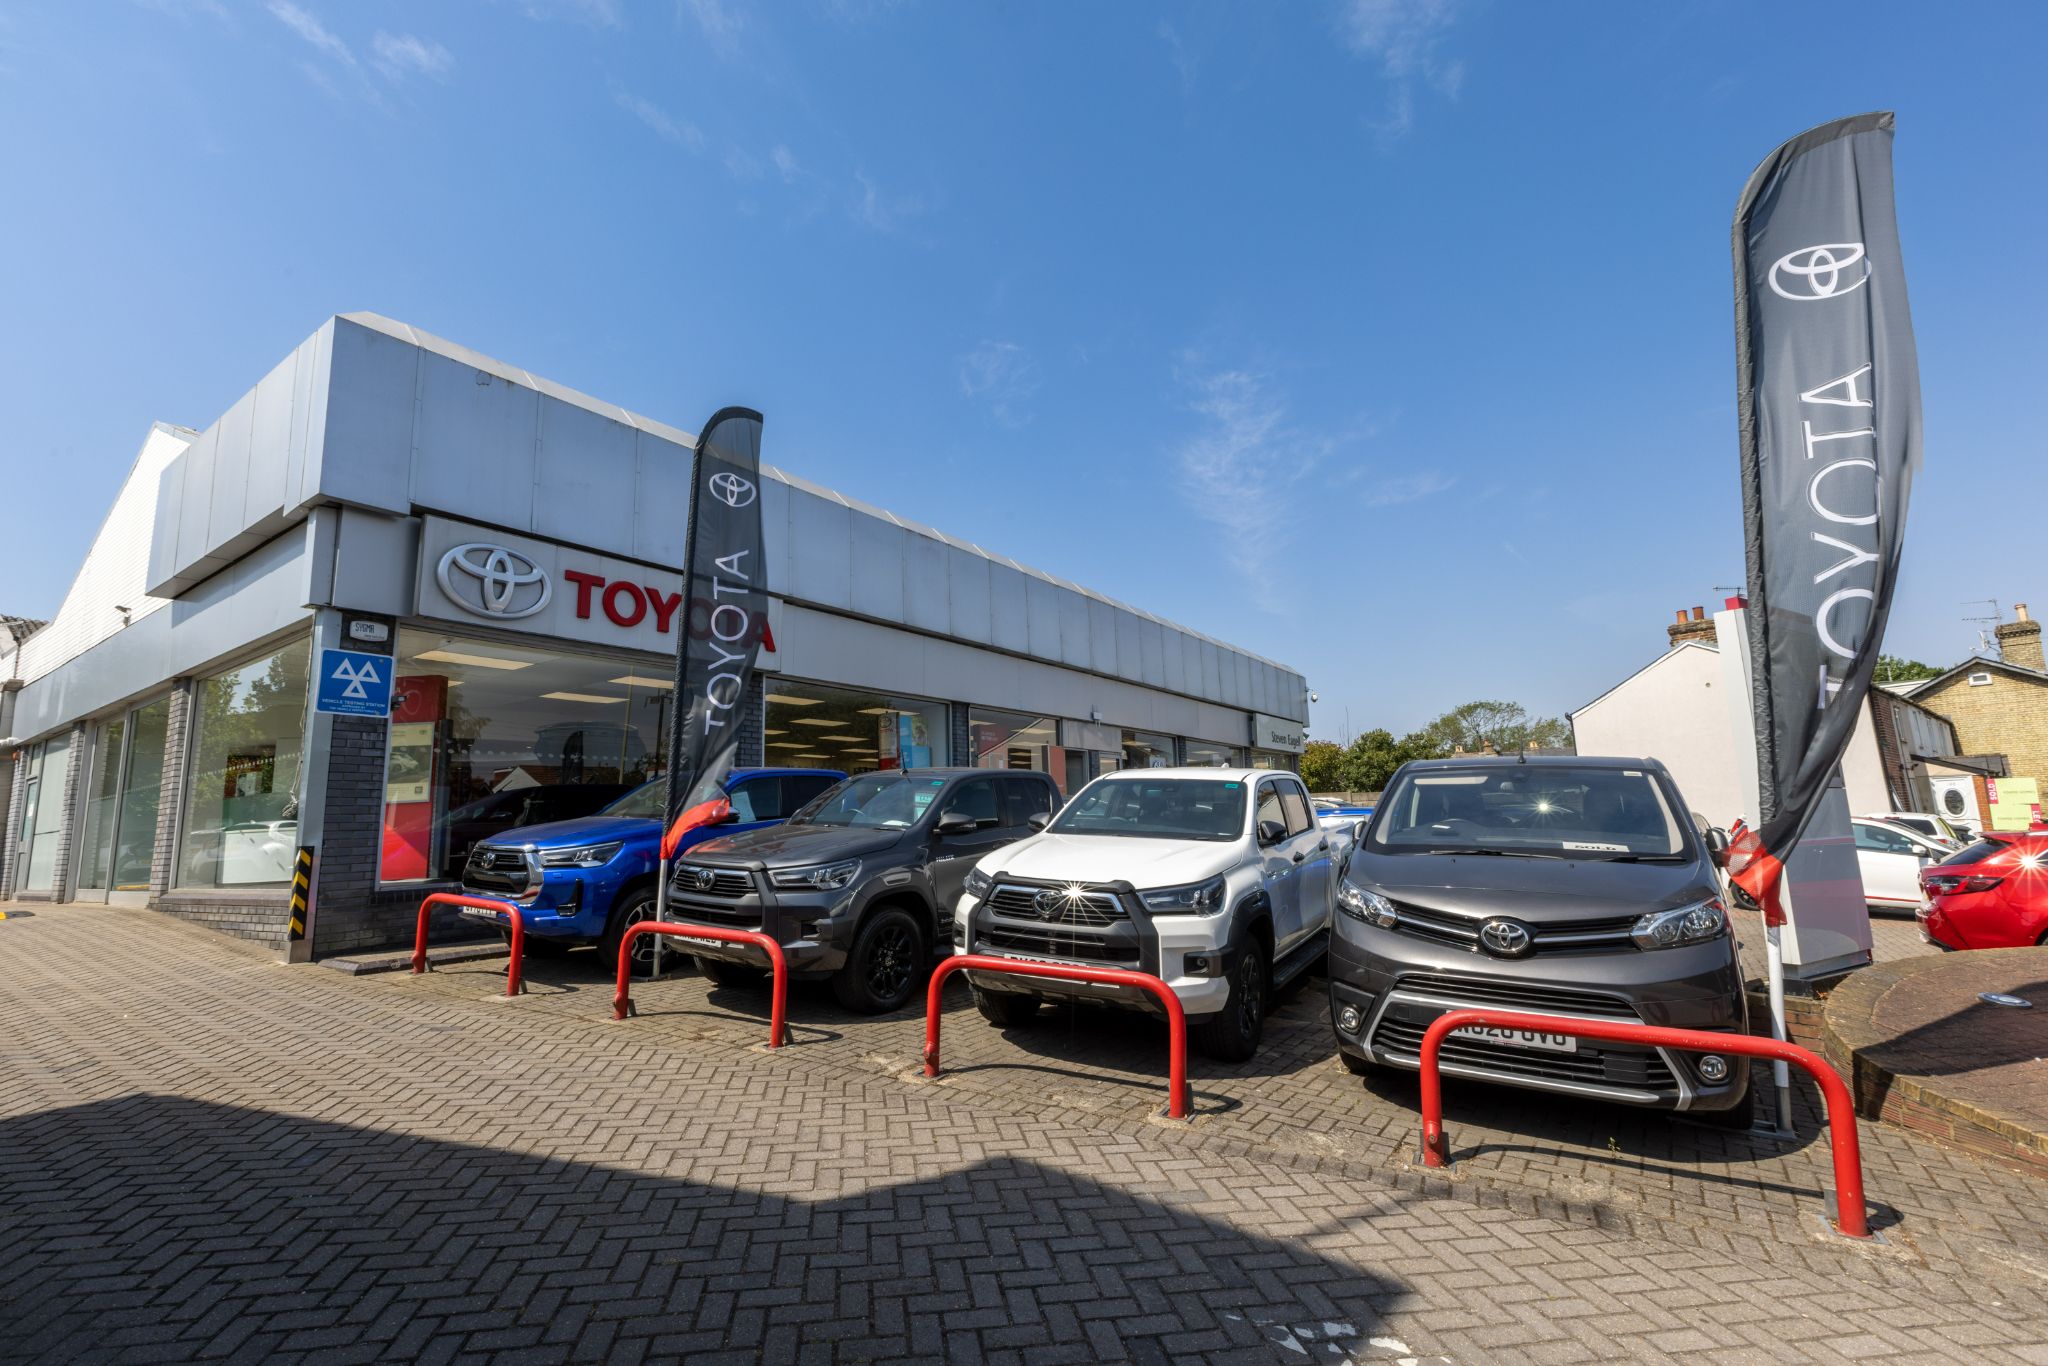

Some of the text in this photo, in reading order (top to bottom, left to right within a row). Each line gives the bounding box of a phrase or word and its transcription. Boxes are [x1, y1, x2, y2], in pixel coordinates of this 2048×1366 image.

[1799, 361, 1882, 710] TOYOTA
[704, 549, 750, 736] TOYOTA
[1271, 731, 1287, 744] Steven
[1988, 783, 1997, 801] SOLD
